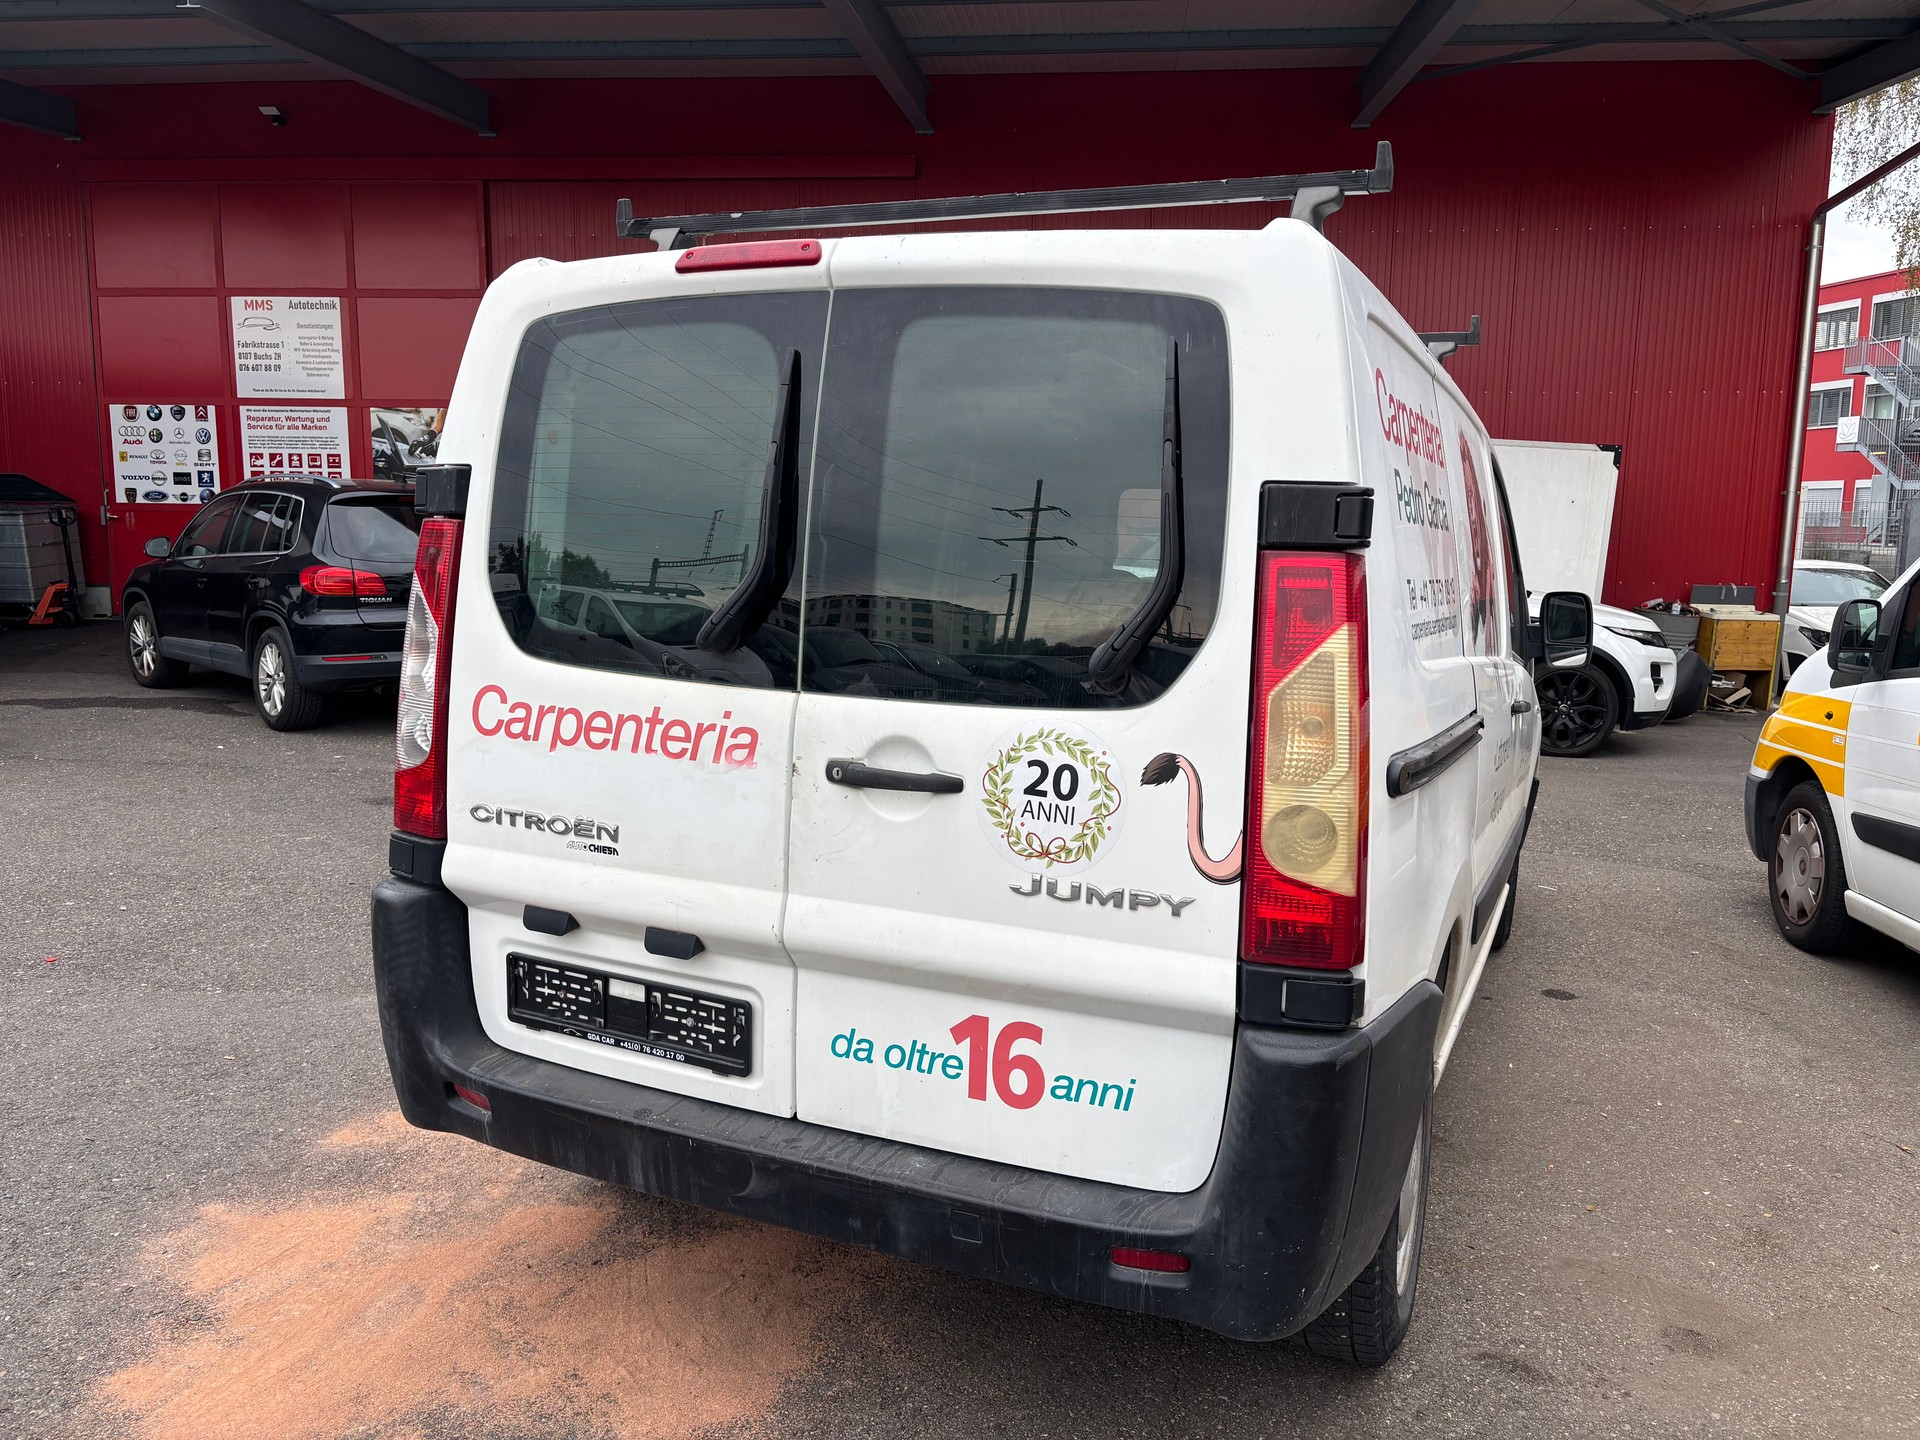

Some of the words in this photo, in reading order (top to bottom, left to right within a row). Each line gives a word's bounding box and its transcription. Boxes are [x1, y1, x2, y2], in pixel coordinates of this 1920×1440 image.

[244, 299, 273, 311] MMS
[288, 300, 338, 310] Autotechnik
[237, 340, 280, 349] Fabrikstrasse
[281, 340, 284, 349] 1
[238, 352, 252, 360] 8107
[254, 352, 272, 360] Buchs
[274, 352, 282, 360] ZH
[239, 364, 250, 372] 076
[252, 364, 262, 372] 607
[274, 364, 282, 372] 09
[246, 415, 283, 423] Reparatur,
[285, 416, 314, 424] Wartung
[1375, 367, 1446, 469] Carpenteria
[1394, 468, 1425, 528] Pedro
[471, 684, 760, 769] Carpenteria
[1023, 759, 1079, 801] 20
[469, 802, 621, 844] CITROËN
[1020, 799, 1076, 826] ANNI
[1008, 872, 1197, 918] JUMPY
[587, 1032, 600, 1042] GDA
[601, 1037, 615, 1045] CAR
[620, 1041, 641, 1052] +41(0)
[642, 1045, 651, 1054] 76
[652, 1048, 665, 1057] 420
[666, 1051, 674, 1059] 17
[675, 1053, 685, 1061] 00
[831, 1028, 875, 1064] da
[884, 1039, 964, 1080] oltre
[949, 1014, 1046, 1110] 16
[1050, 1074, 1137, 1112] anni
